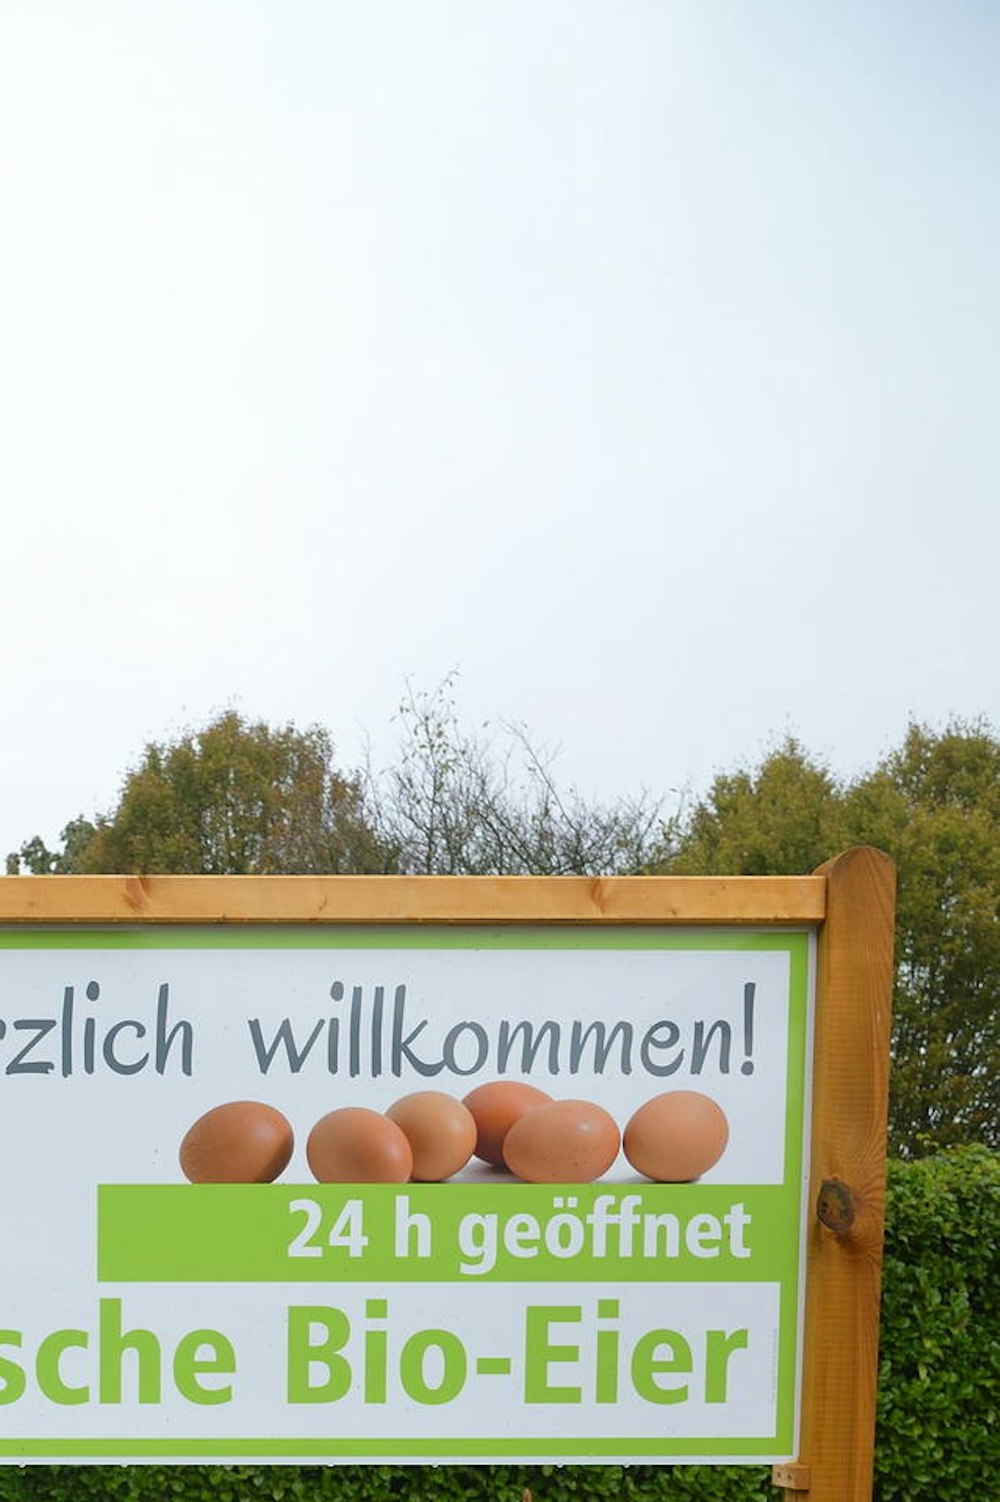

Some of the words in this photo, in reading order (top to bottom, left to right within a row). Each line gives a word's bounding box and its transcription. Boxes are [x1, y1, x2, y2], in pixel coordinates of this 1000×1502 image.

[247, 981, 756, 1078] willkommen!
[288, 1199, 368, 1257] 24
[395, 1195, 432, 1257] h
[459, 1195, 752, 1275] geöffnet
[287, 1298, 749, 1406] Bio-Eier
